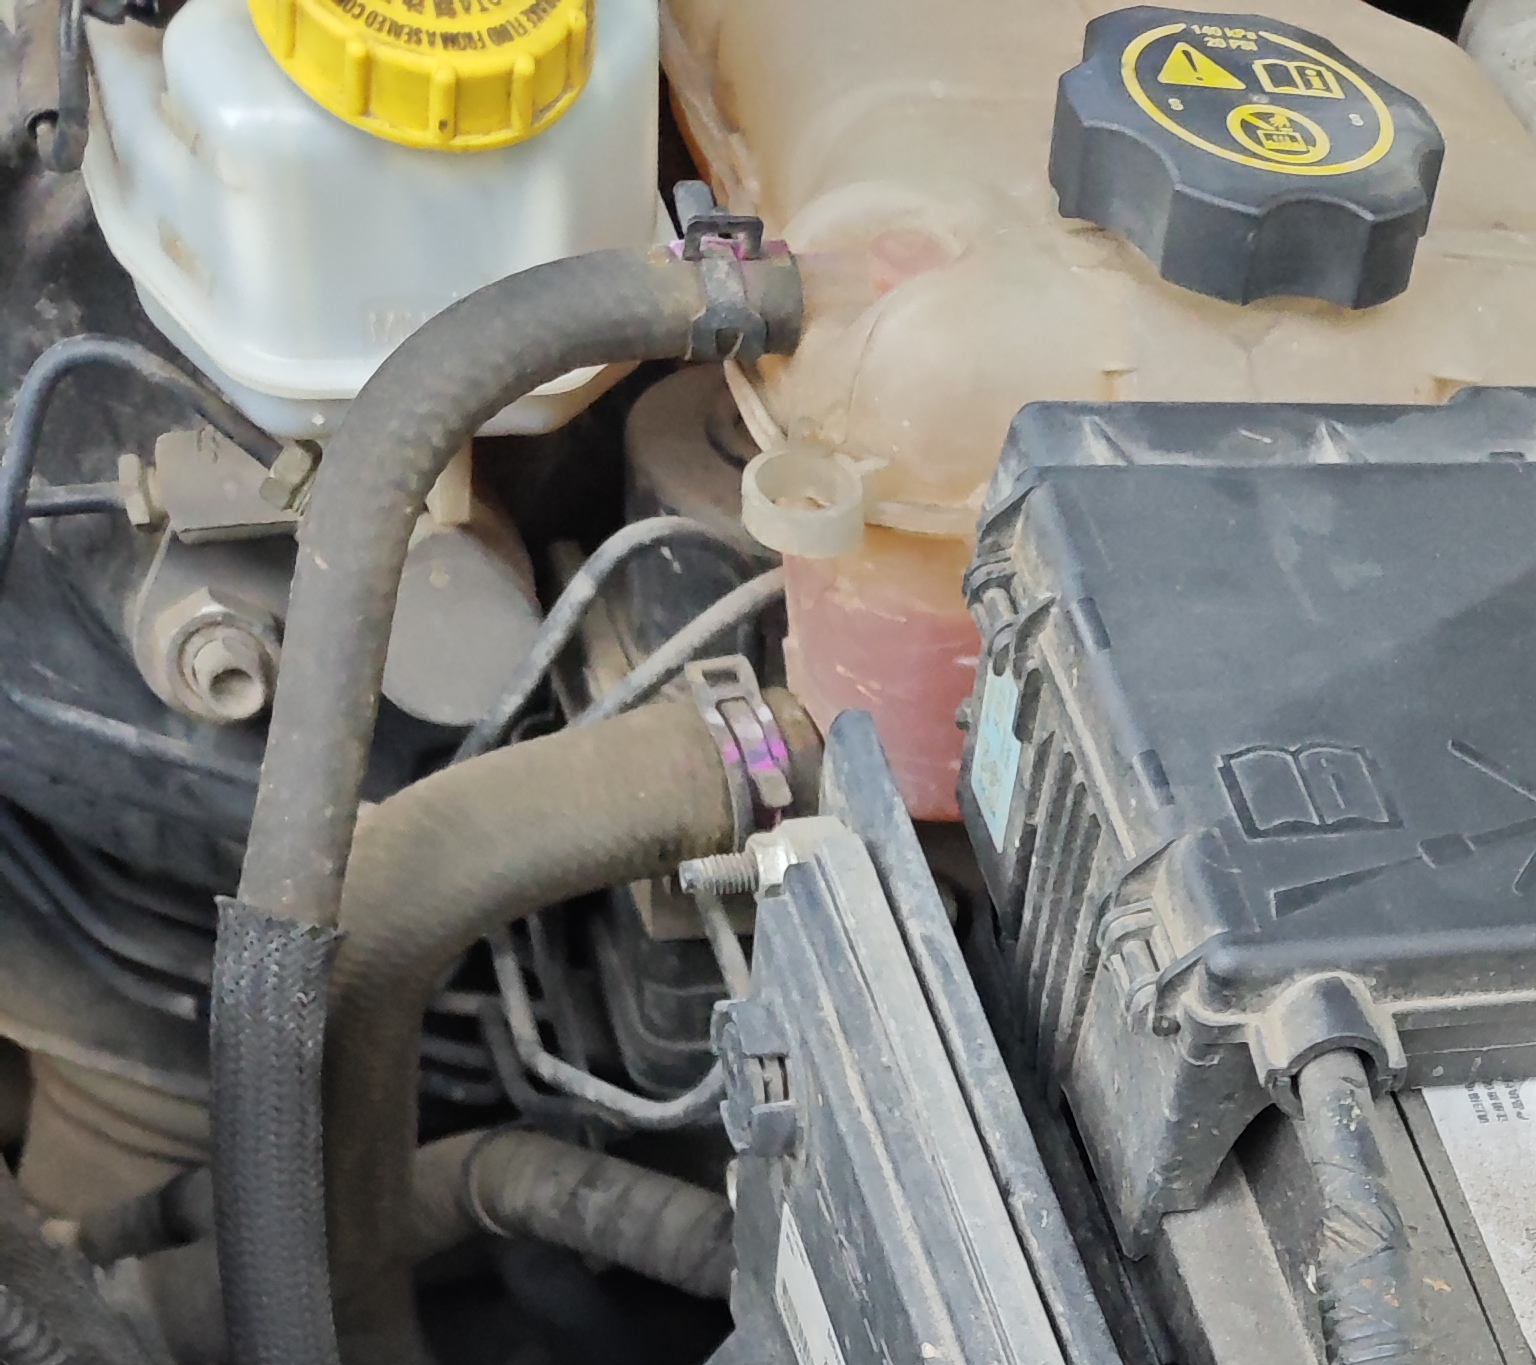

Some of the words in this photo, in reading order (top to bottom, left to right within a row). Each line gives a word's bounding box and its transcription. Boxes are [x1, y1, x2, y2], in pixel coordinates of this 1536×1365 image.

[364, 10, 423, 45] SEALED
[426, 29, 437, 47] A
[440, 31, 486, 50] FROM
